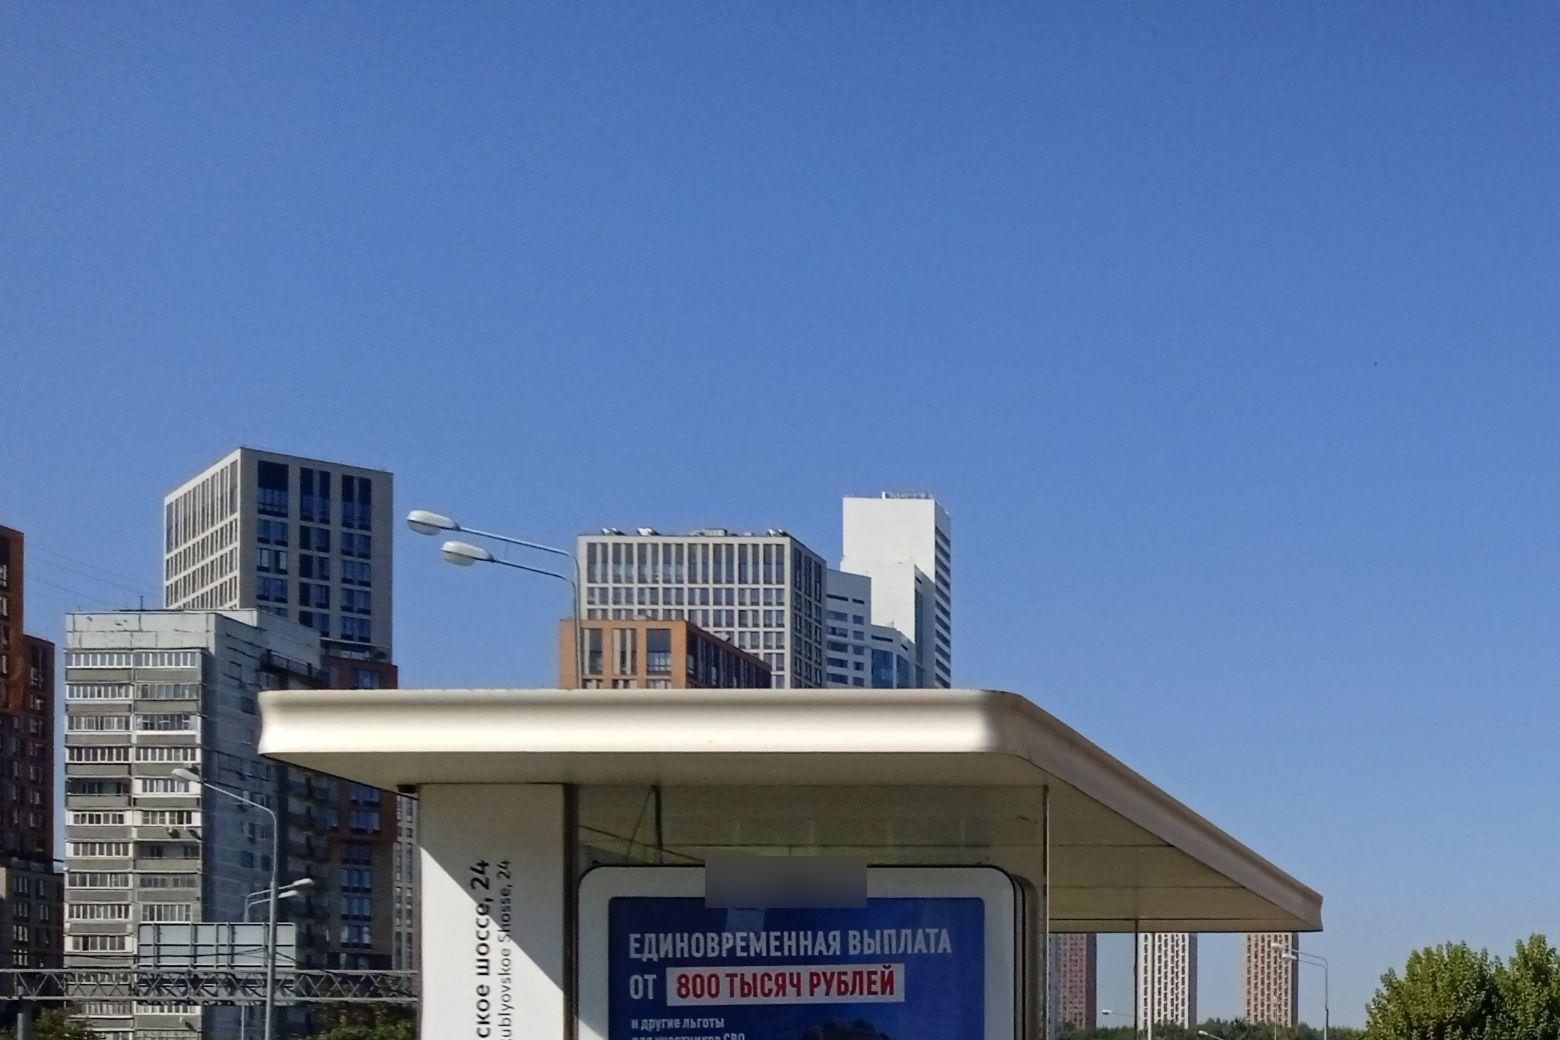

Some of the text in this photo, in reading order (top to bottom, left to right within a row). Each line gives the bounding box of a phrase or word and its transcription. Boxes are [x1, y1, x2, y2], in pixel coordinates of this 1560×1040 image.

[470, 859, 491, 891] 24
[497, 860, 512, 881] 24
[499, 884, 514, 943] Shosse,
[475, 897, 494, 976] шоссе,
[628, 928, 952, 962] ЕДИНОВРЕМЕННАЯ ВЫПЛАТА
[629, 964, 896, 1000] ОТ 800 ТЫСЯЧ РУБЛЕЙ
[630, 1017, 725, 1032] и другие льготы
